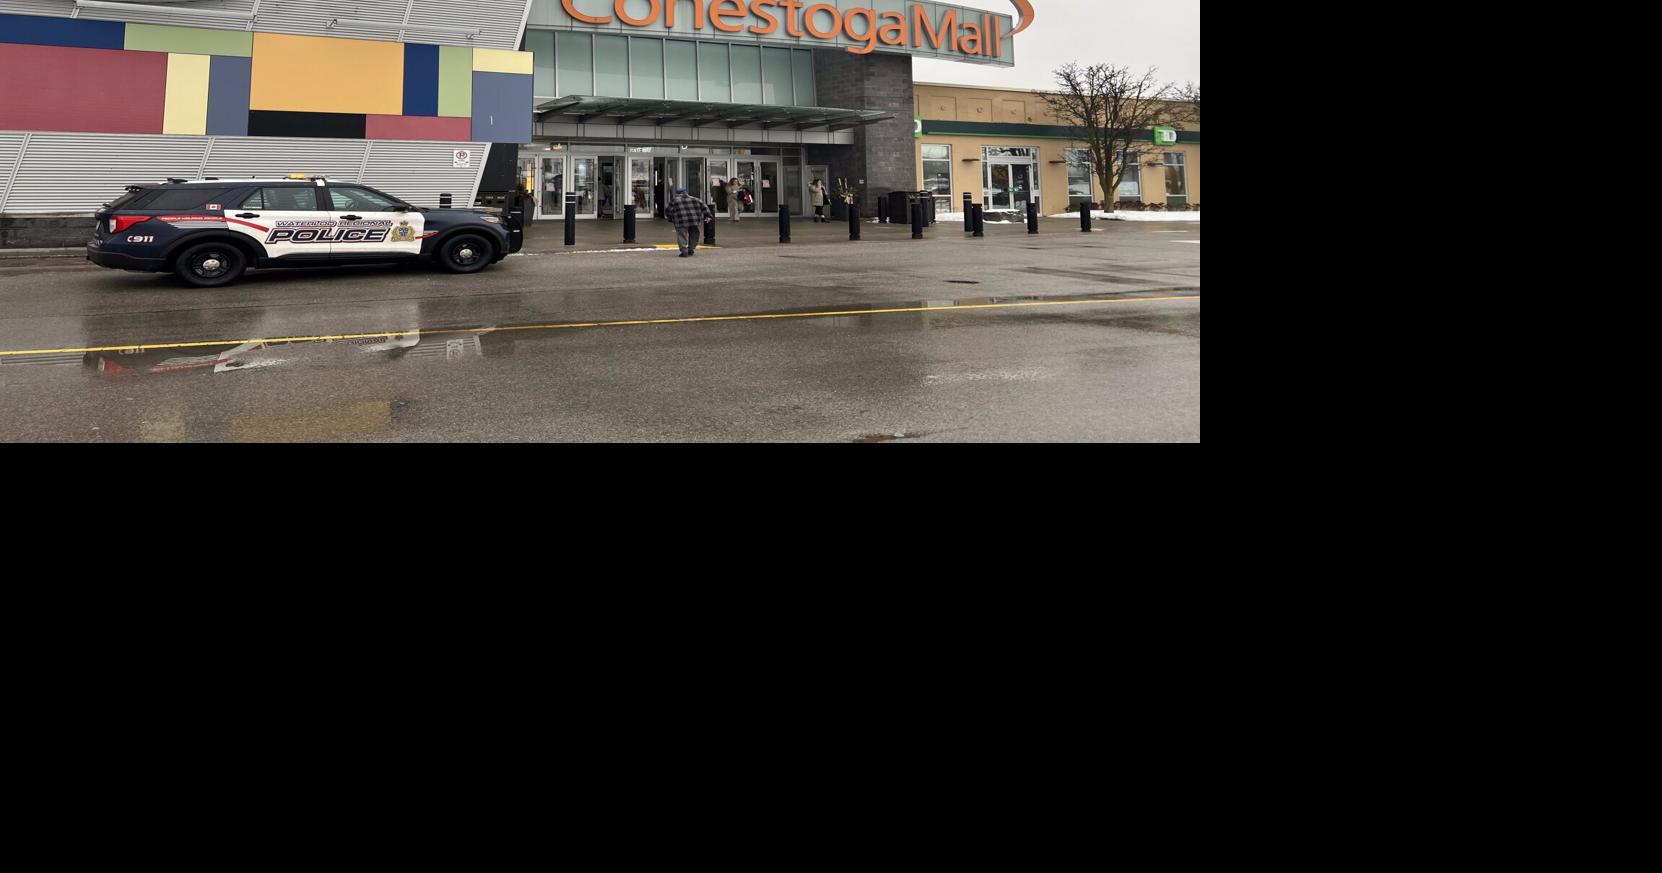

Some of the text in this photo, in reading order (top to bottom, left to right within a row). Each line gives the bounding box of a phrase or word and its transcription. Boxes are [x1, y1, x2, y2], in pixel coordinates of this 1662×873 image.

[275, 219, 392, 228] WATERLOO REGIONAL
[133, 235, 154, 243] 911
[265, 227, 391, 244] POLICE
